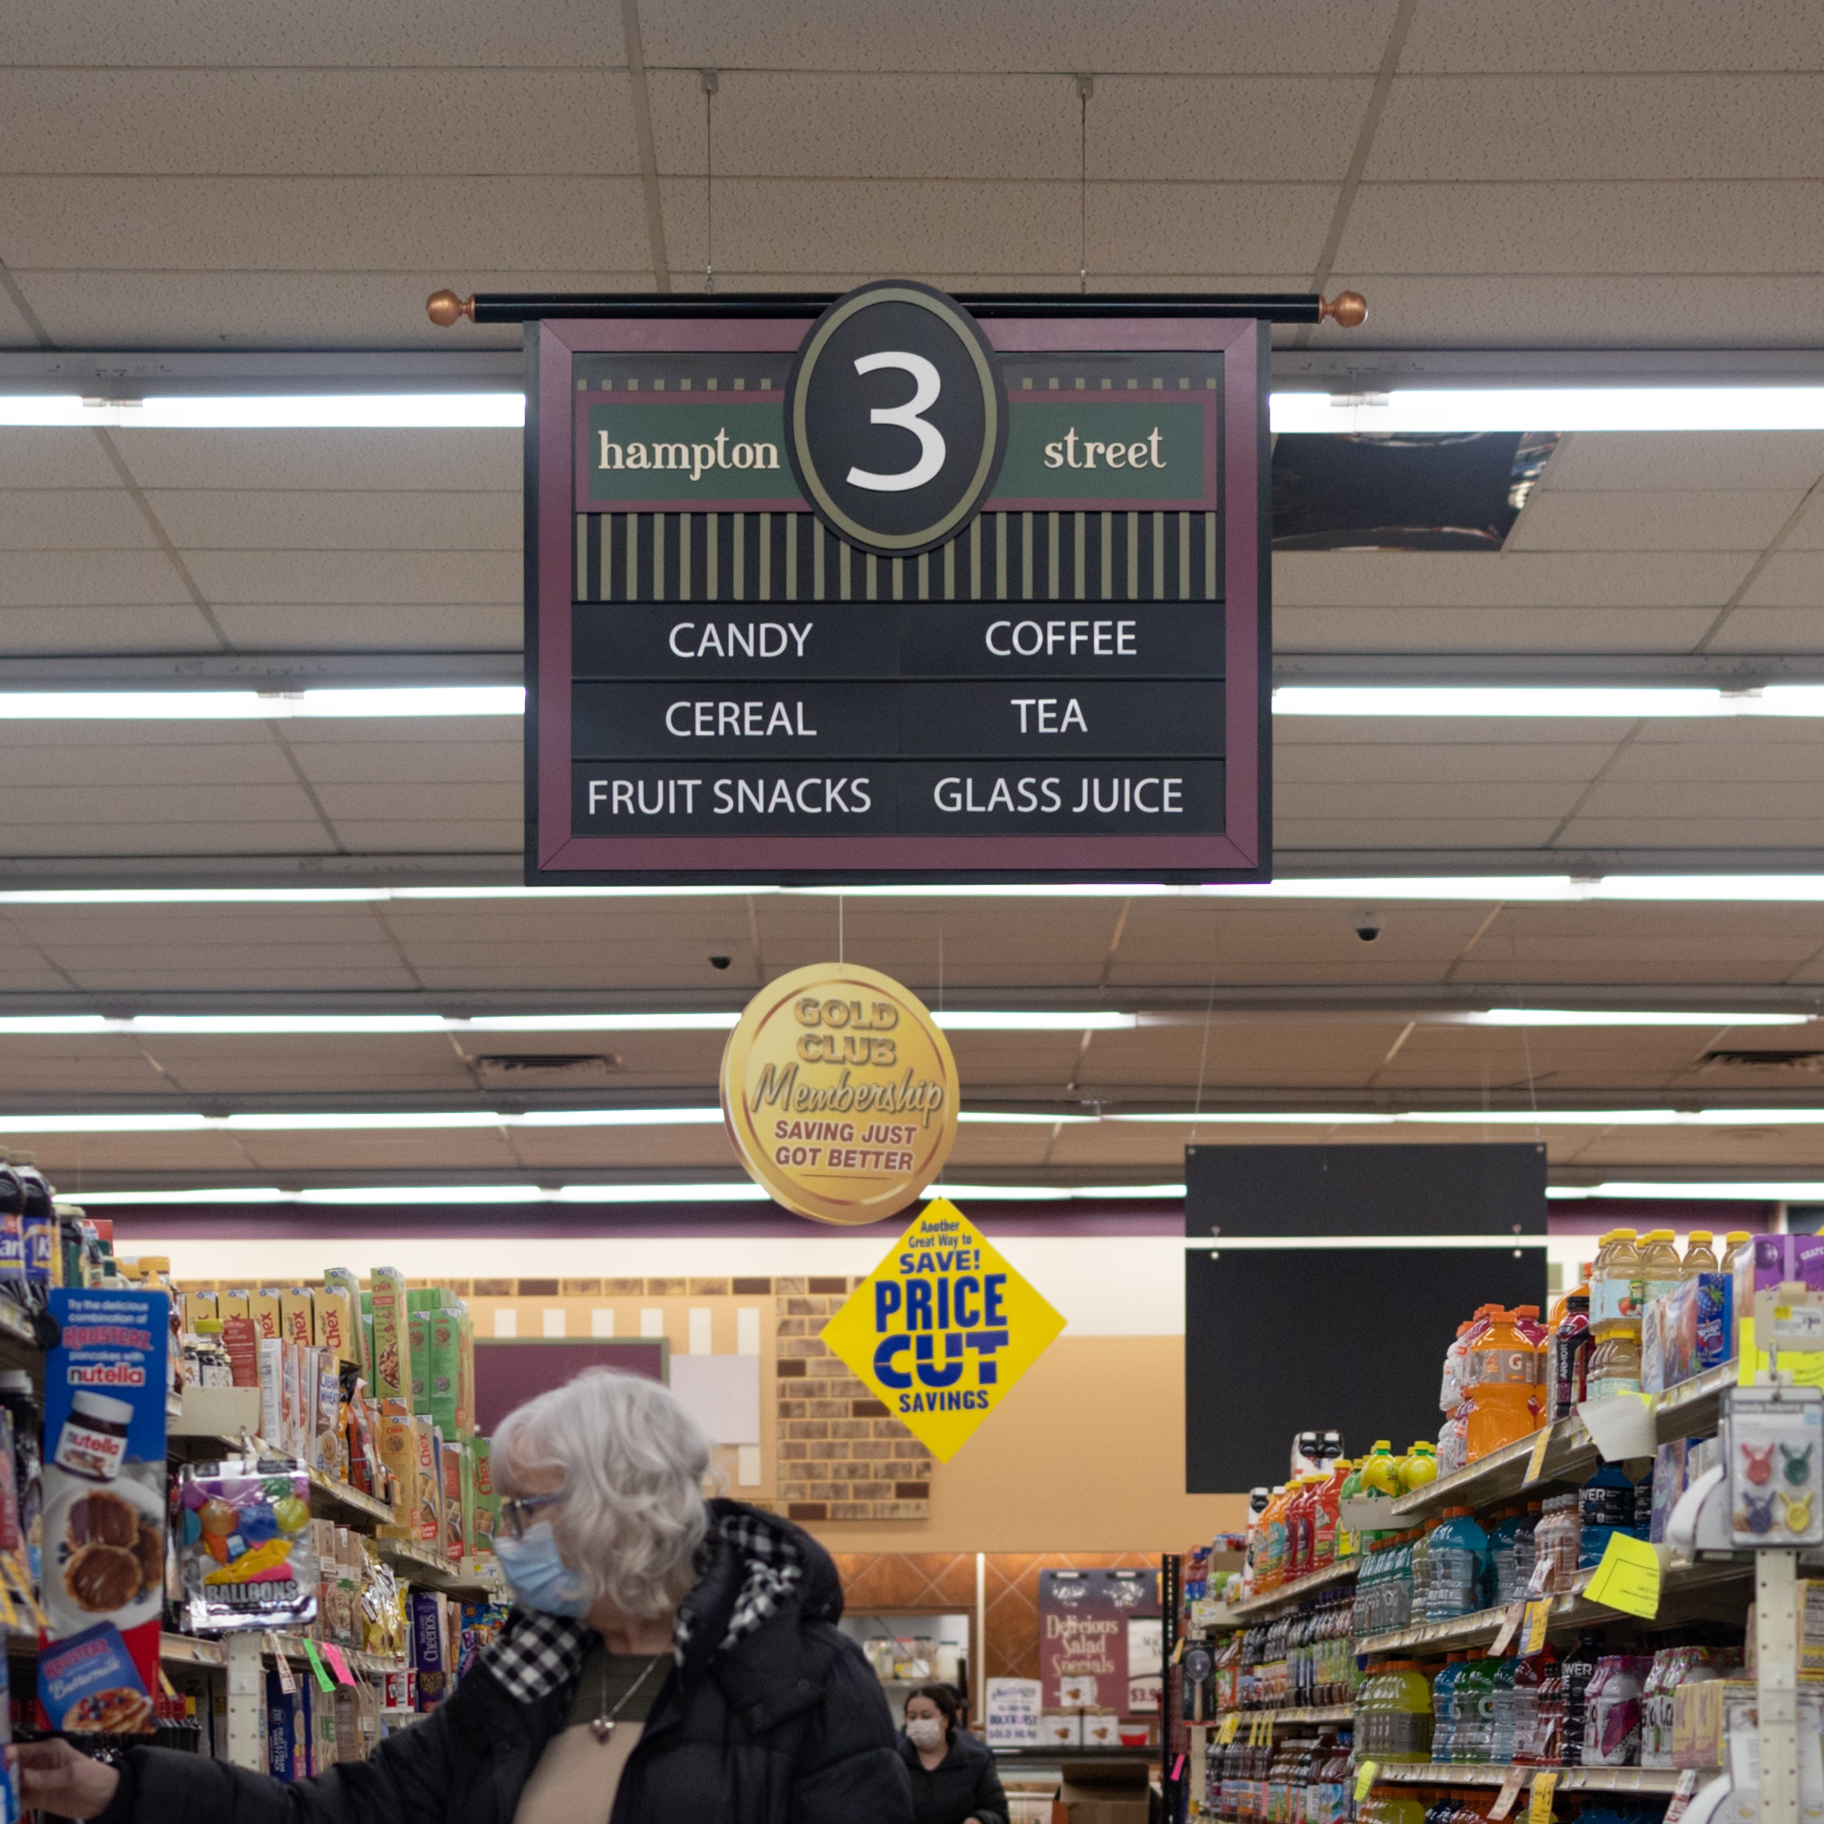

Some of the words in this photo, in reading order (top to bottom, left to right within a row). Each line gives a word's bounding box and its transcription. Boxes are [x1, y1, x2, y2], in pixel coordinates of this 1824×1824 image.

[846, 350, 947, 492] 3
[598, 427, 780, 481] hampton
[1044, 426, 1167, 470] street
[669, 622, 813, 658] CANDY
[985, 620, 1138, 656] COFFEE
[665, 701, 816, 737] CEREAL
[1011, 698, 1087, 734] TEA
[588, 779, 702, 815] FRUIT
[713, 778, 871, 814] SNACKS
[934, 776, 1062, 812] GLASS
[1070, 776, 1183, 813] JUICE
[794, 998, 898, 1030] GOLD
[796, 1034, 896, 1065] CLUB
[751, 1062, 944, 1128] Membership
[774, 1120, 854, 1142] SAVING
[862, 1123, 917, 1146] JUST
[776, 1147, 821, 1167] GOT
[827, 1149, 913, 1171] BETTER
[920, 1218, 960, 1233] Another
[908, 1234, 934, 1247] Great
[938, 1234, 958, 1250] Way
[962, 1233, 972, 1245] to
[1800, 1246, 1824, 1261] GRAPE
[899, 1249, 981, 1274] SAVE!
[68, 1298, 82, 1311] Try
[83, 1299, 101, 1311] the
[102, 1300, 149, 1312] delicious
[874, 1273, 1008, 1333] PRICE
[68, 1313, 134, 1324] combination
[326, 1309, 342, 1348] Chex
[62, 1326, 155, 1351] KRUSTEAZ
[69, 1350, 122, 1361] pancakes
[873, 1330, 1010, 1388] CUT
[1508, 1353, 1522, 1370] G
[68, 1364, 144, 1385] nutella
[899, 1390, 989, 1413] SAVINGS
[67, 1431, 120, 1456] nutella
[419, 1434, 432, 1467] Chex
[1579, 1488, 1607, 1501] WER
[206, 1580, 298, 1602] BALLOONS
[424, 1612, 439, 1663] Cheerios
[1045, 1614, 1119, 1640] Delicious
[1062, 1633, 1107, 1657] Salad
[1051, 1654, 1116, 1677] Specials
[1563, 1662, 1593, 1678] WER
